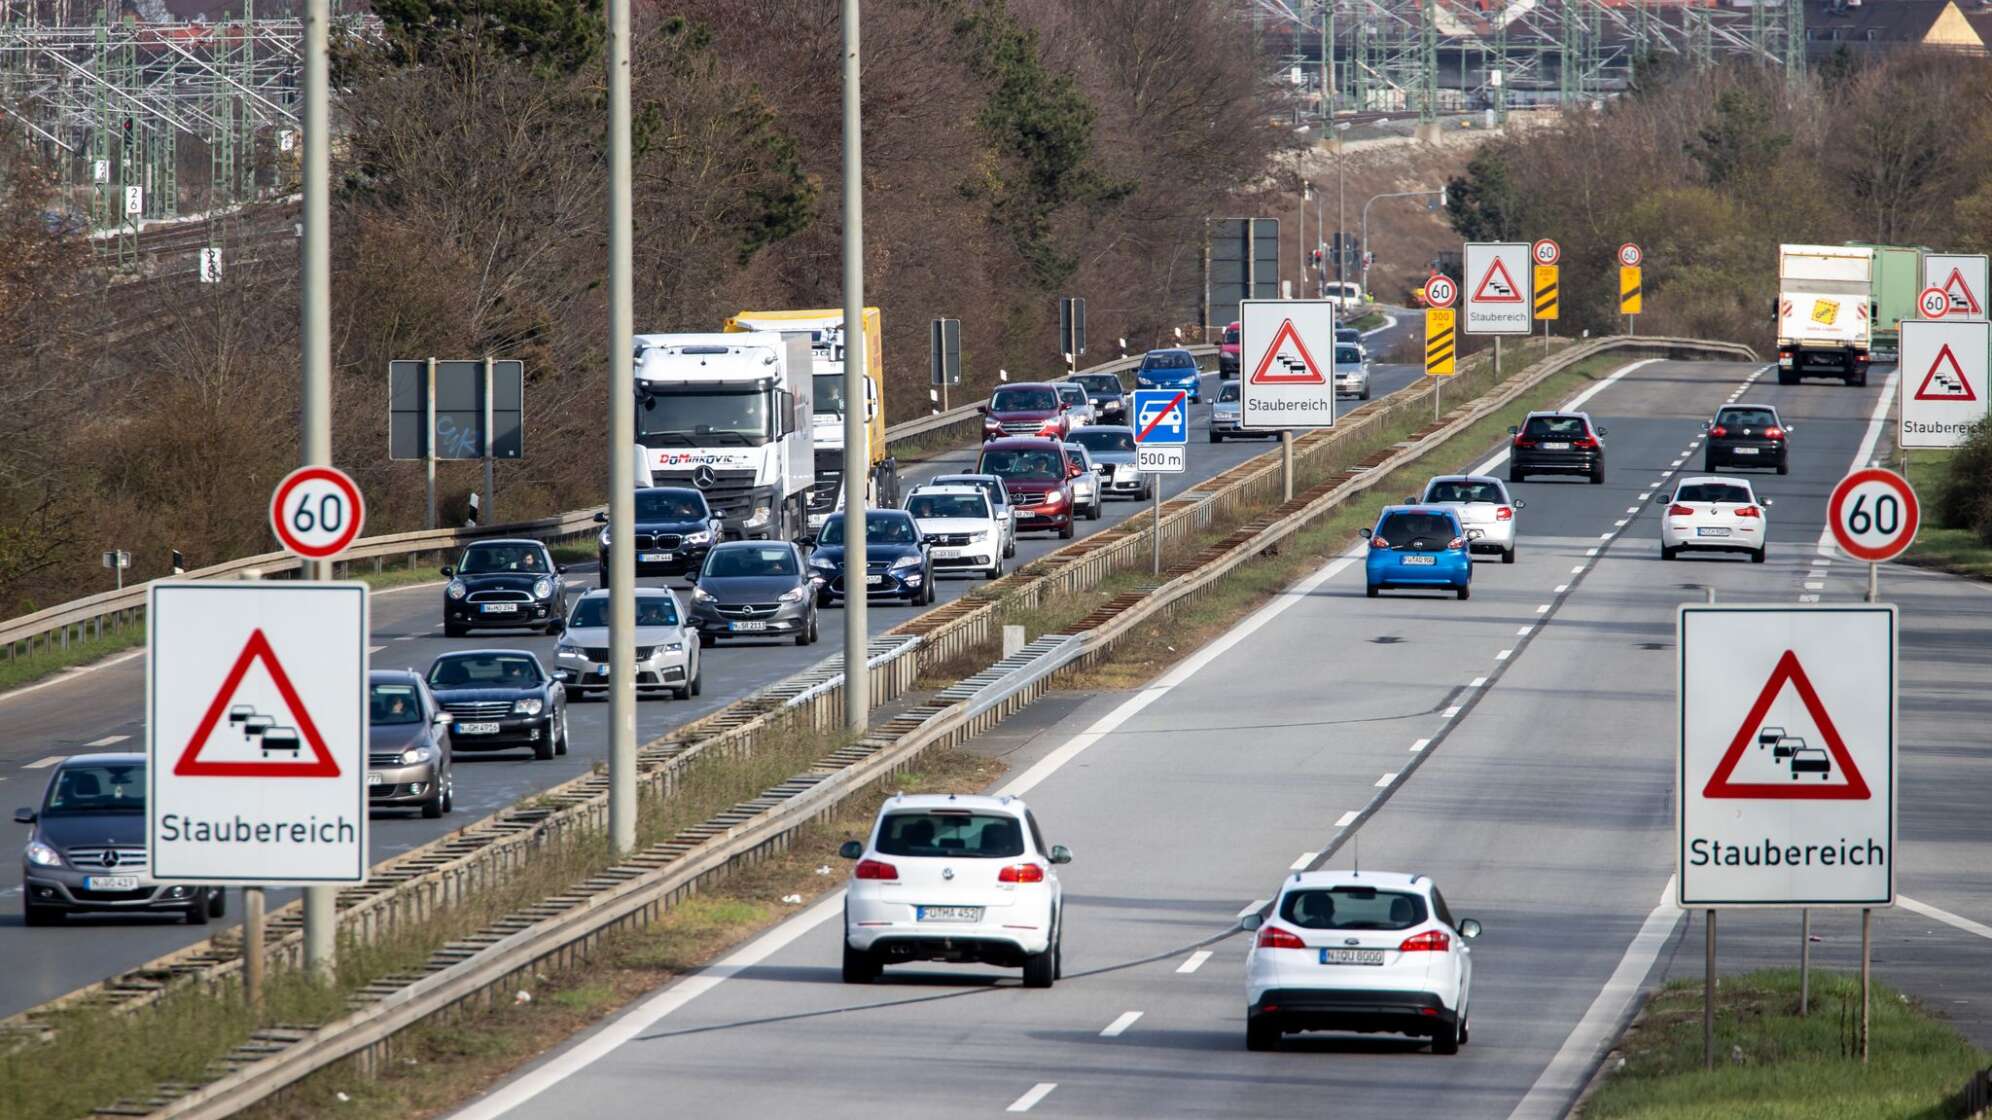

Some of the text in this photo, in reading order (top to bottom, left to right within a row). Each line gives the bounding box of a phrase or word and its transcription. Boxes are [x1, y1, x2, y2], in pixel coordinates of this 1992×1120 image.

[1538, 246, 1554, 259] 60
[1624, 250, 1637, 261] 60
[1431, 284, 1450, 299] 60
[1925, 296, 1944, 311] 60
[1432, 312, 1450, 321] 300
[1470, 311, 1527, 322] Staubereich
[1249, 398, 1328, 412] Staubereich
[1904, 420, 1985, 433] Stauberec
[1140, 452, 1181, 466] 500 m
[293, 492, 344, 534] 60
[1848, 493, 1899, 535] 60
[161, 813, 355, 843] Staubereich
[1690, 838, 1885, 868] Staubereich
[957, 906, 976, 918] 452
[1328, 951, 1334, 961] N
[1356, 951, 1382, 962] 8000
